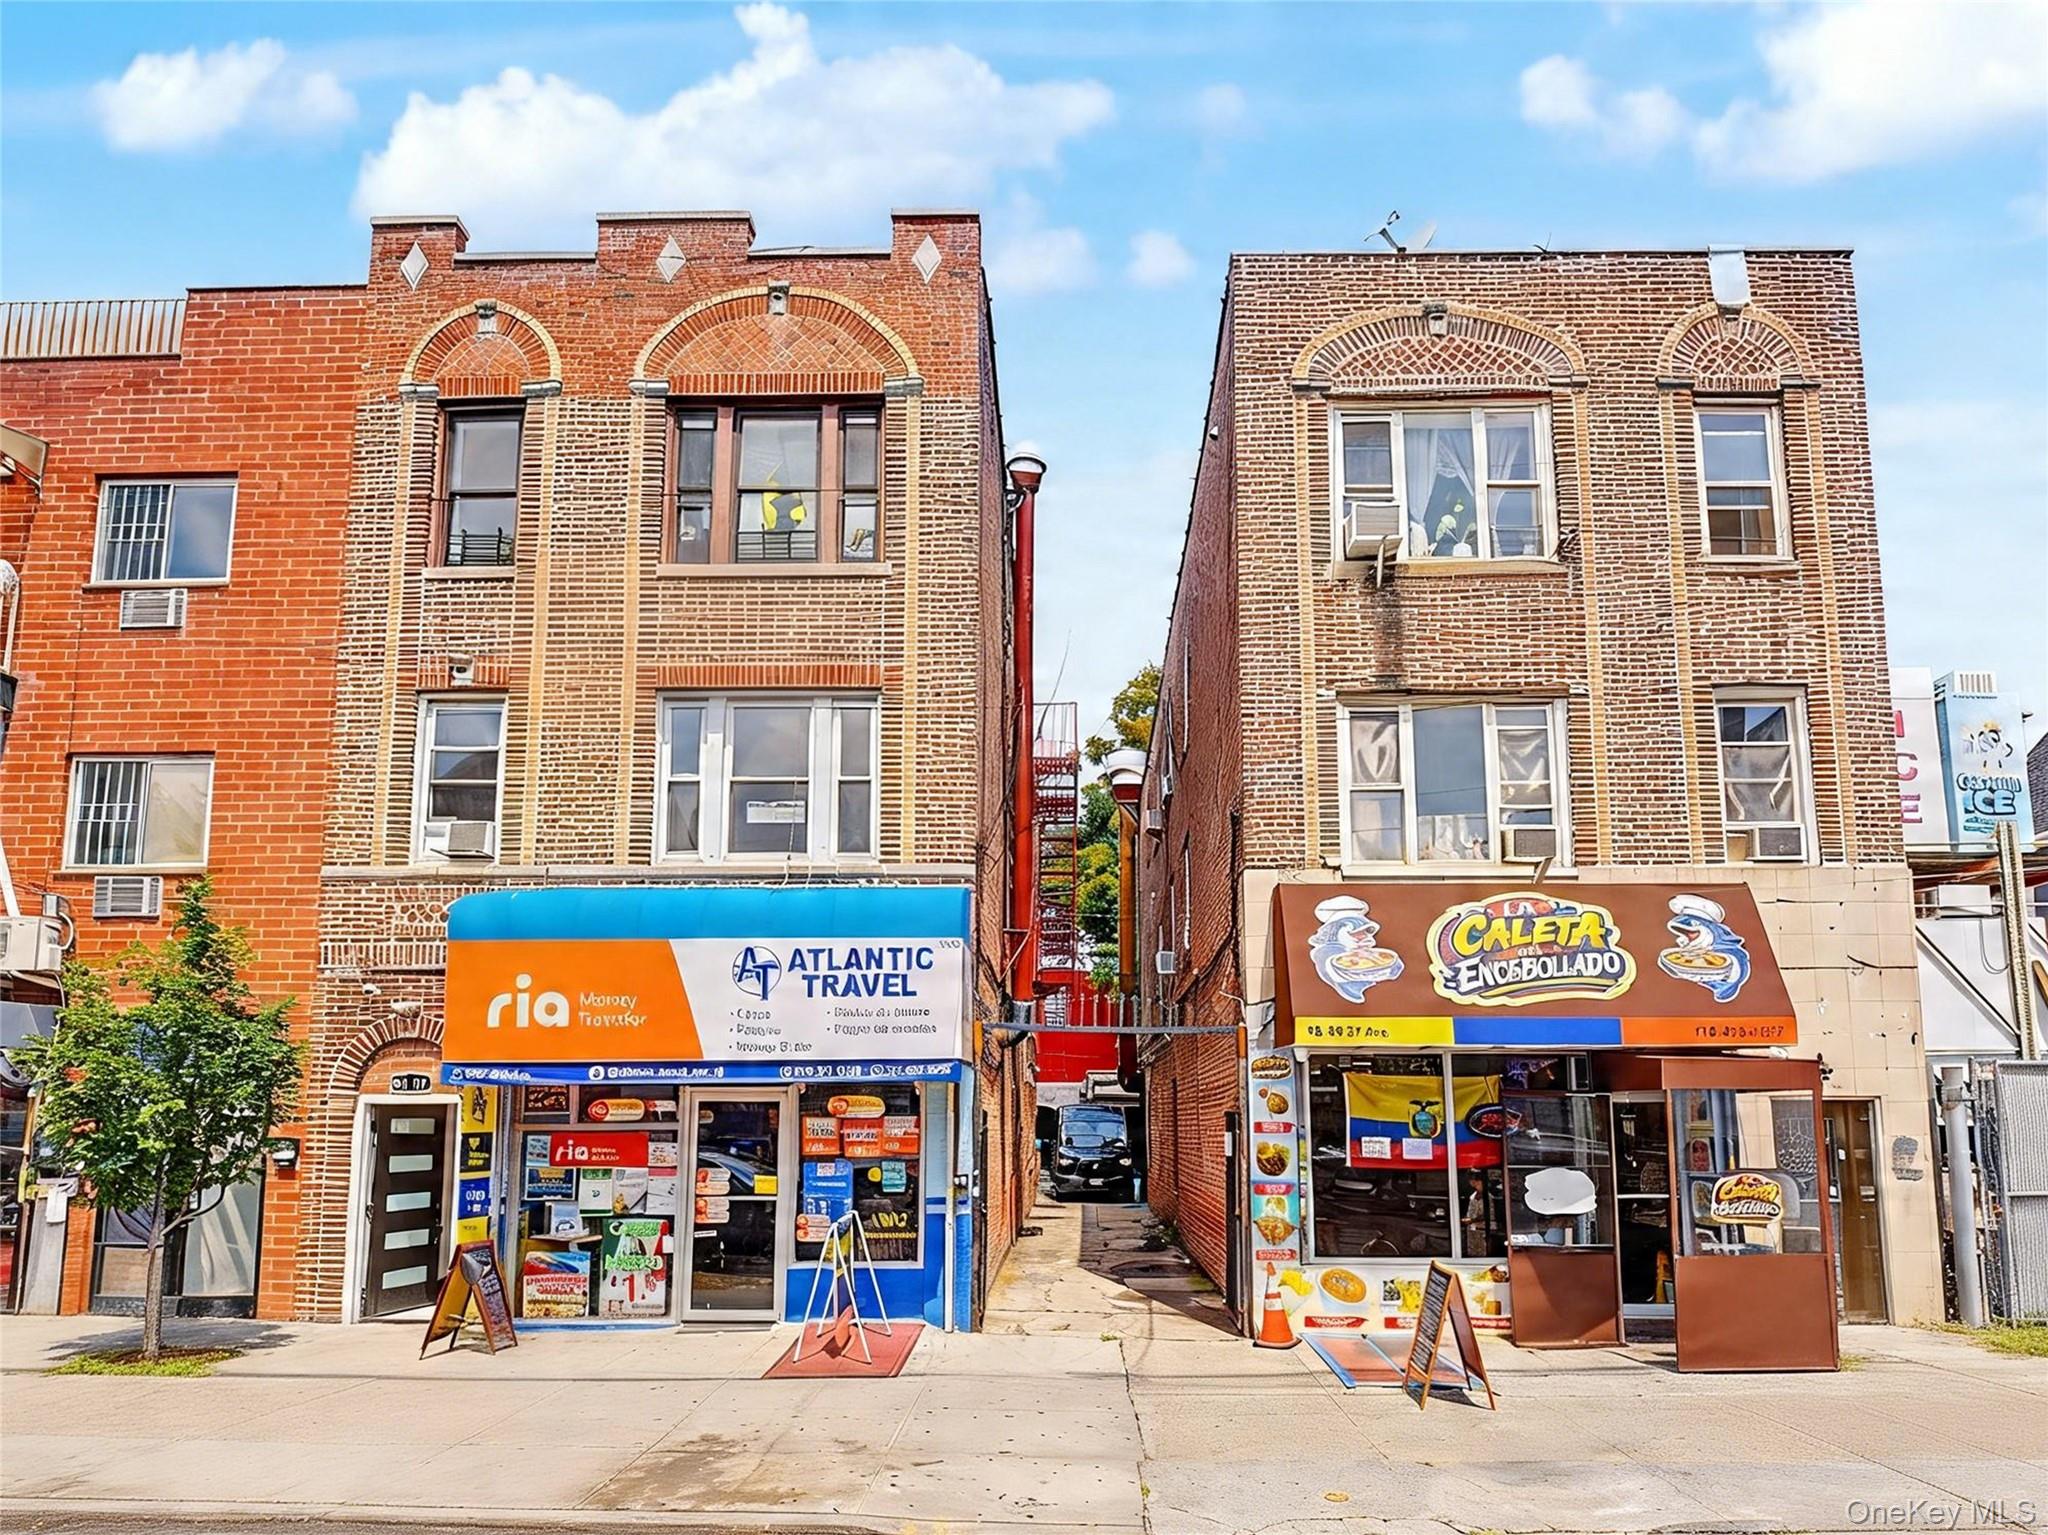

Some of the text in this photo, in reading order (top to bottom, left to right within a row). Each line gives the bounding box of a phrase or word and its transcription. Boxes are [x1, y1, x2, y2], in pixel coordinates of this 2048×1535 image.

[1452, 911, 1607, 957] CALETA
[787, 947, 934, 973] ATLANTIC
[801, 972, 917, 998] TRAVEL
[487, 973, 570, 1028] ria
[555, 1139, 589, 1162] ria
